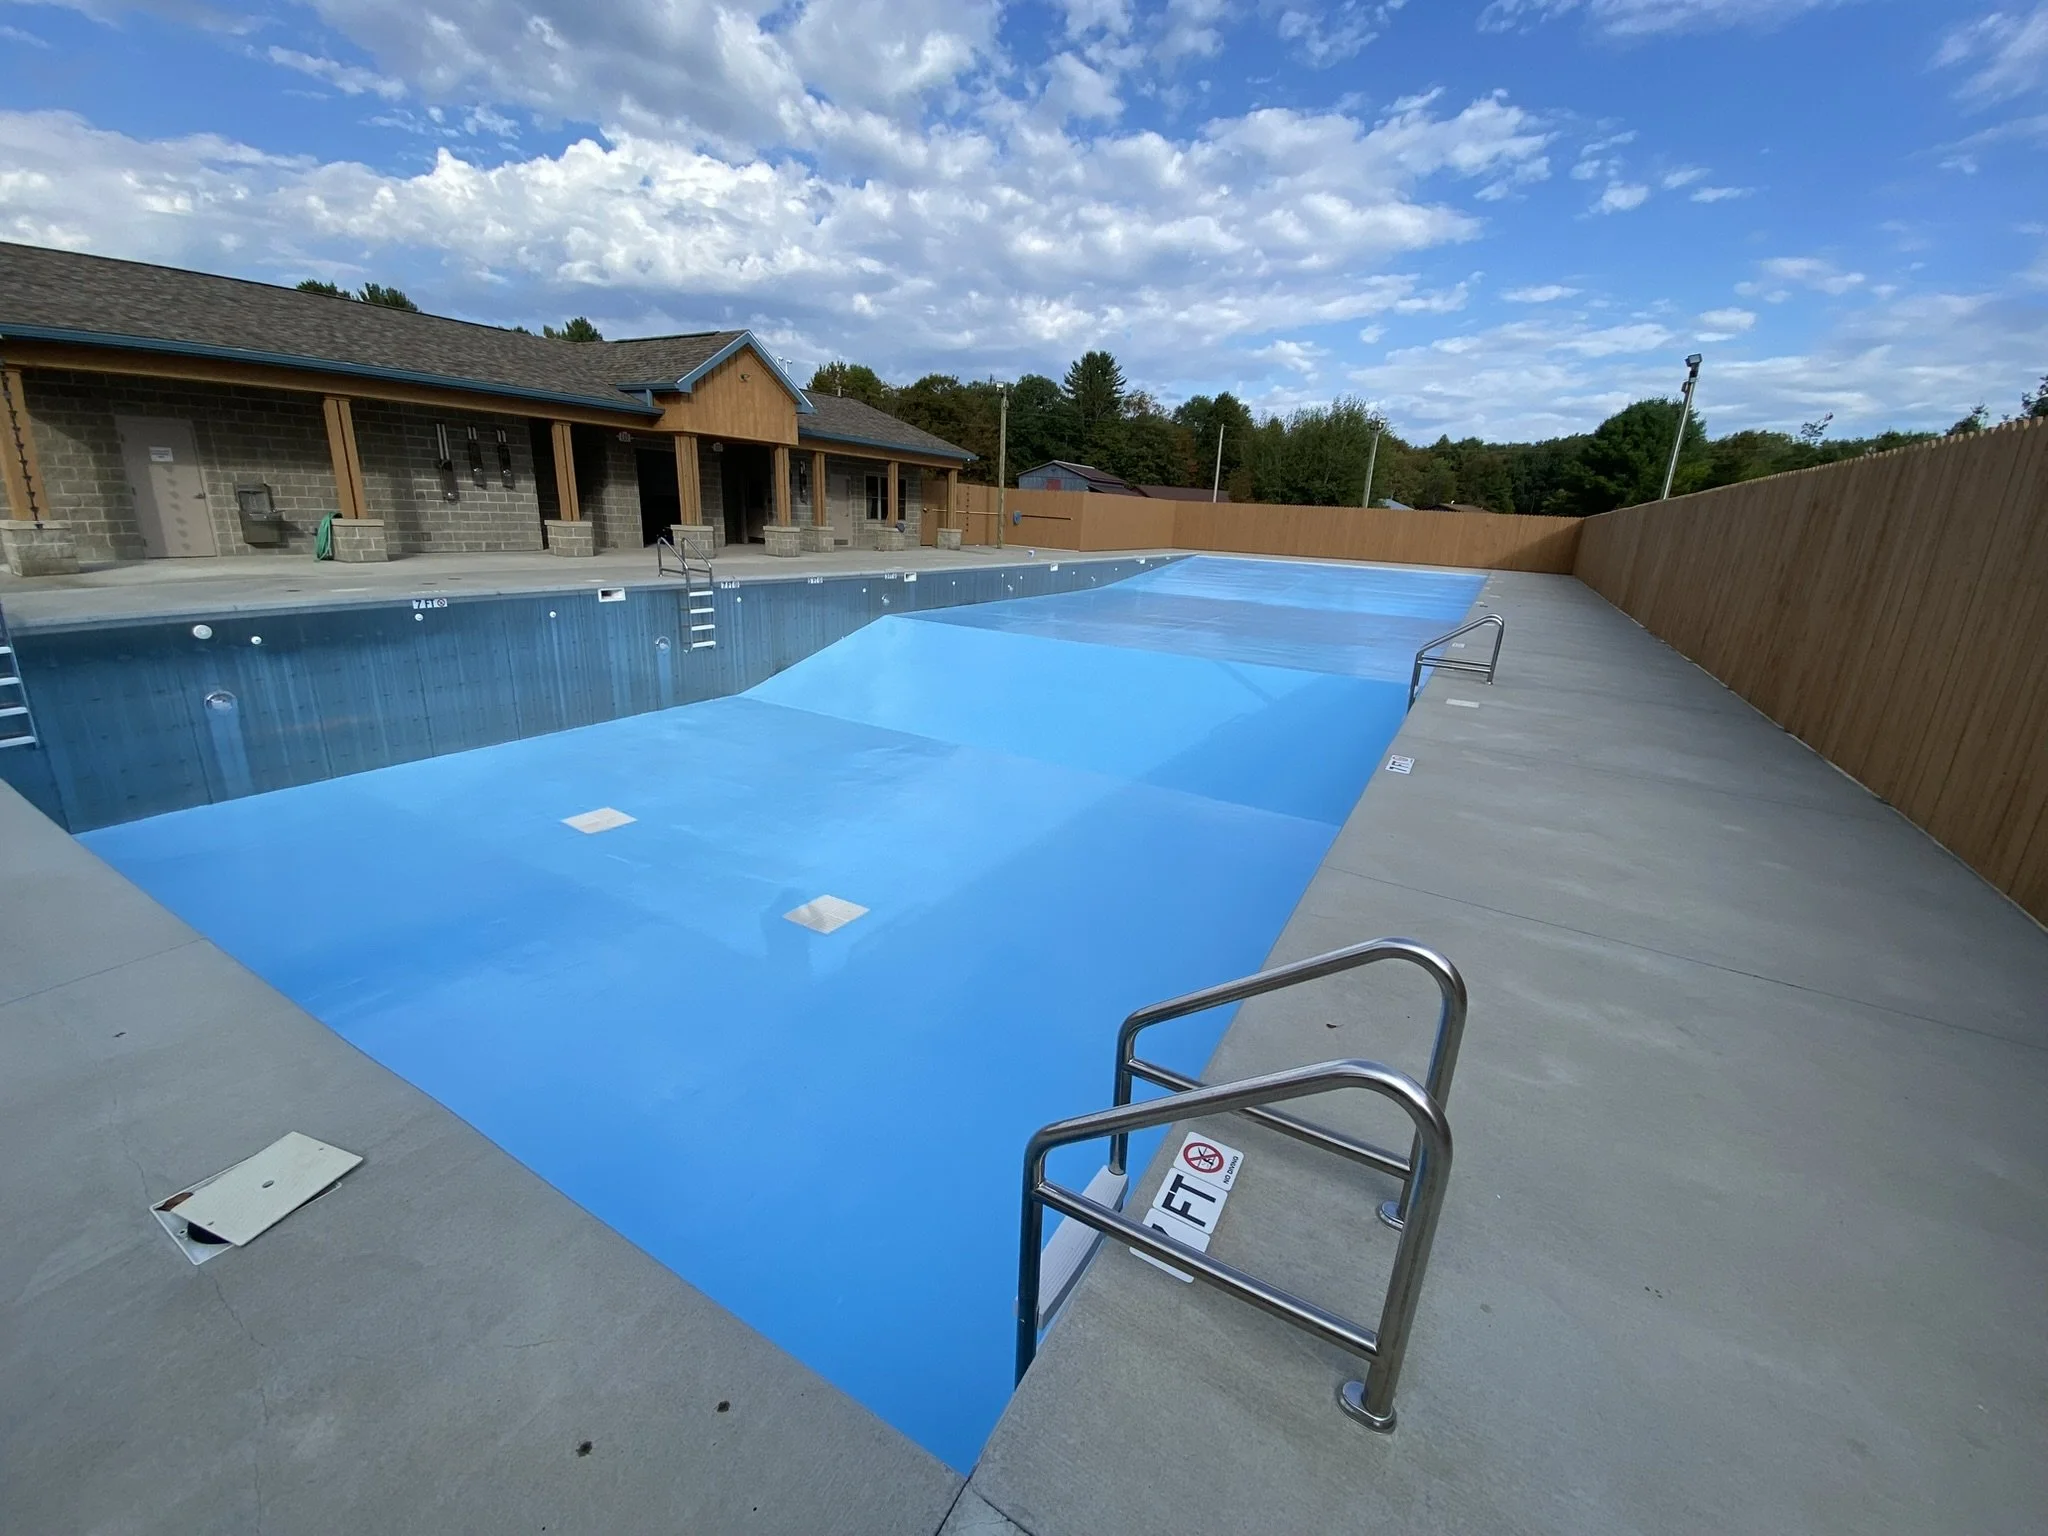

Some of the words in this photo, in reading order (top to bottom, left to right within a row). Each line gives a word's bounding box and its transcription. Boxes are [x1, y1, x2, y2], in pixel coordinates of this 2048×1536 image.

[1223, 1174, 1231, 1184] NO
[1227, 1155, 1239, 1175] DIVING
[1162, 1174, 1216, 1227] FT
